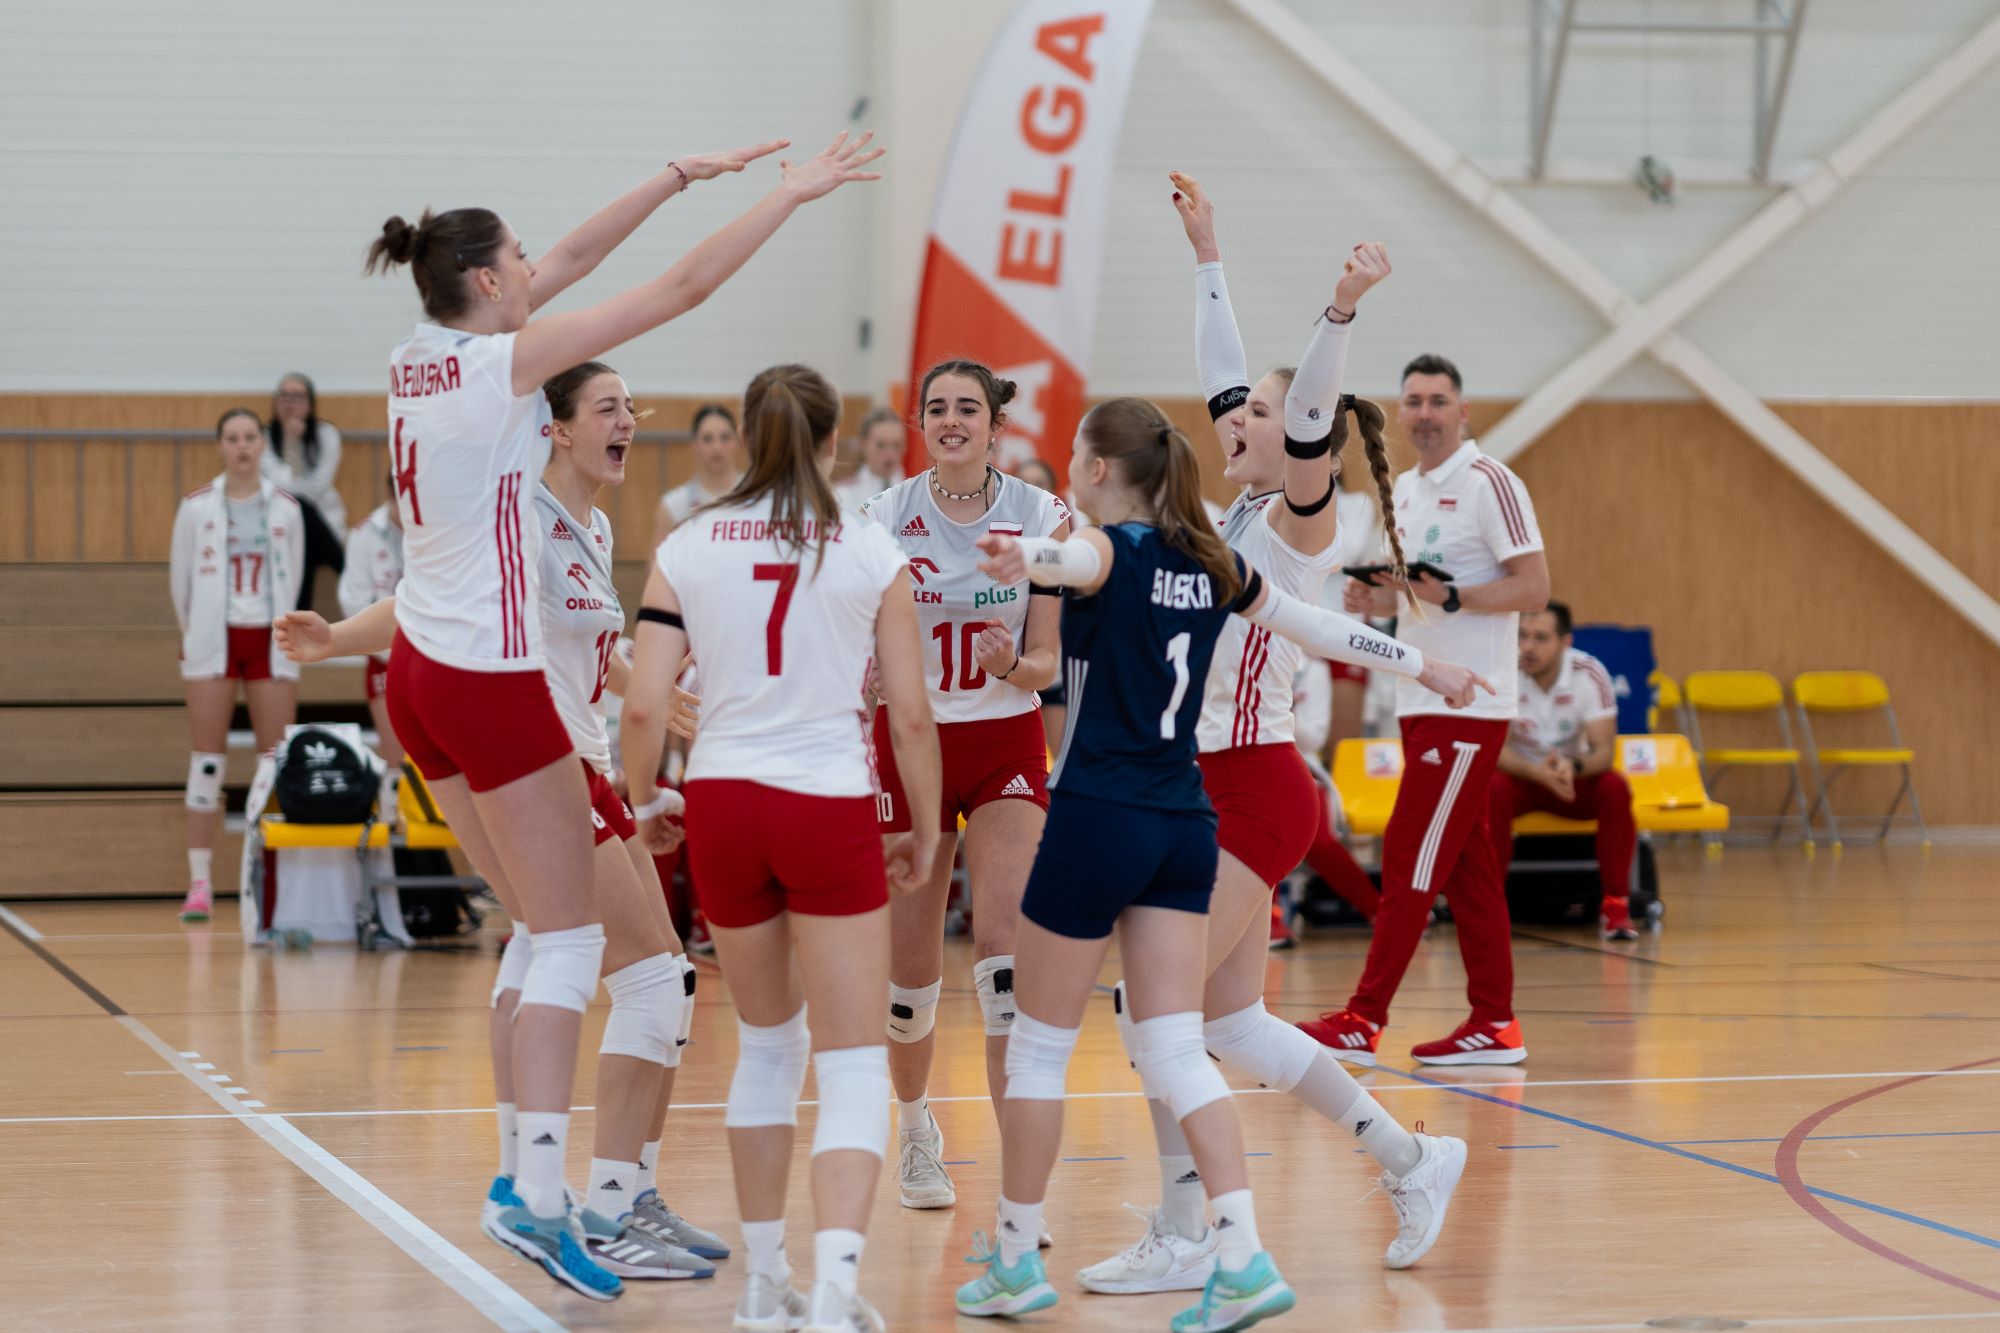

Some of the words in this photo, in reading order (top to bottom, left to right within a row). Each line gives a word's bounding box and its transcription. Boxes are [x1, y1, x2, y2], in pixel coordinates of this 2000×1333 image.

[996, 12, 1106, 288] ELGA
[390, 355, 461, 398] LEWSKA
[395, 417, 423, 527] 4
[900, 528, 930, 537] adidas
[230, 553, 263, 594] 17
[974, 587, 1018, 609] plus
[754, 564, 799, 676] 7
[932, 621, 987, 693] 10
[1348, 633, 1395, 659] TERREX
[1160, 632, 1191, 741] 1
[1001, 786, 1035, 796] adidas
